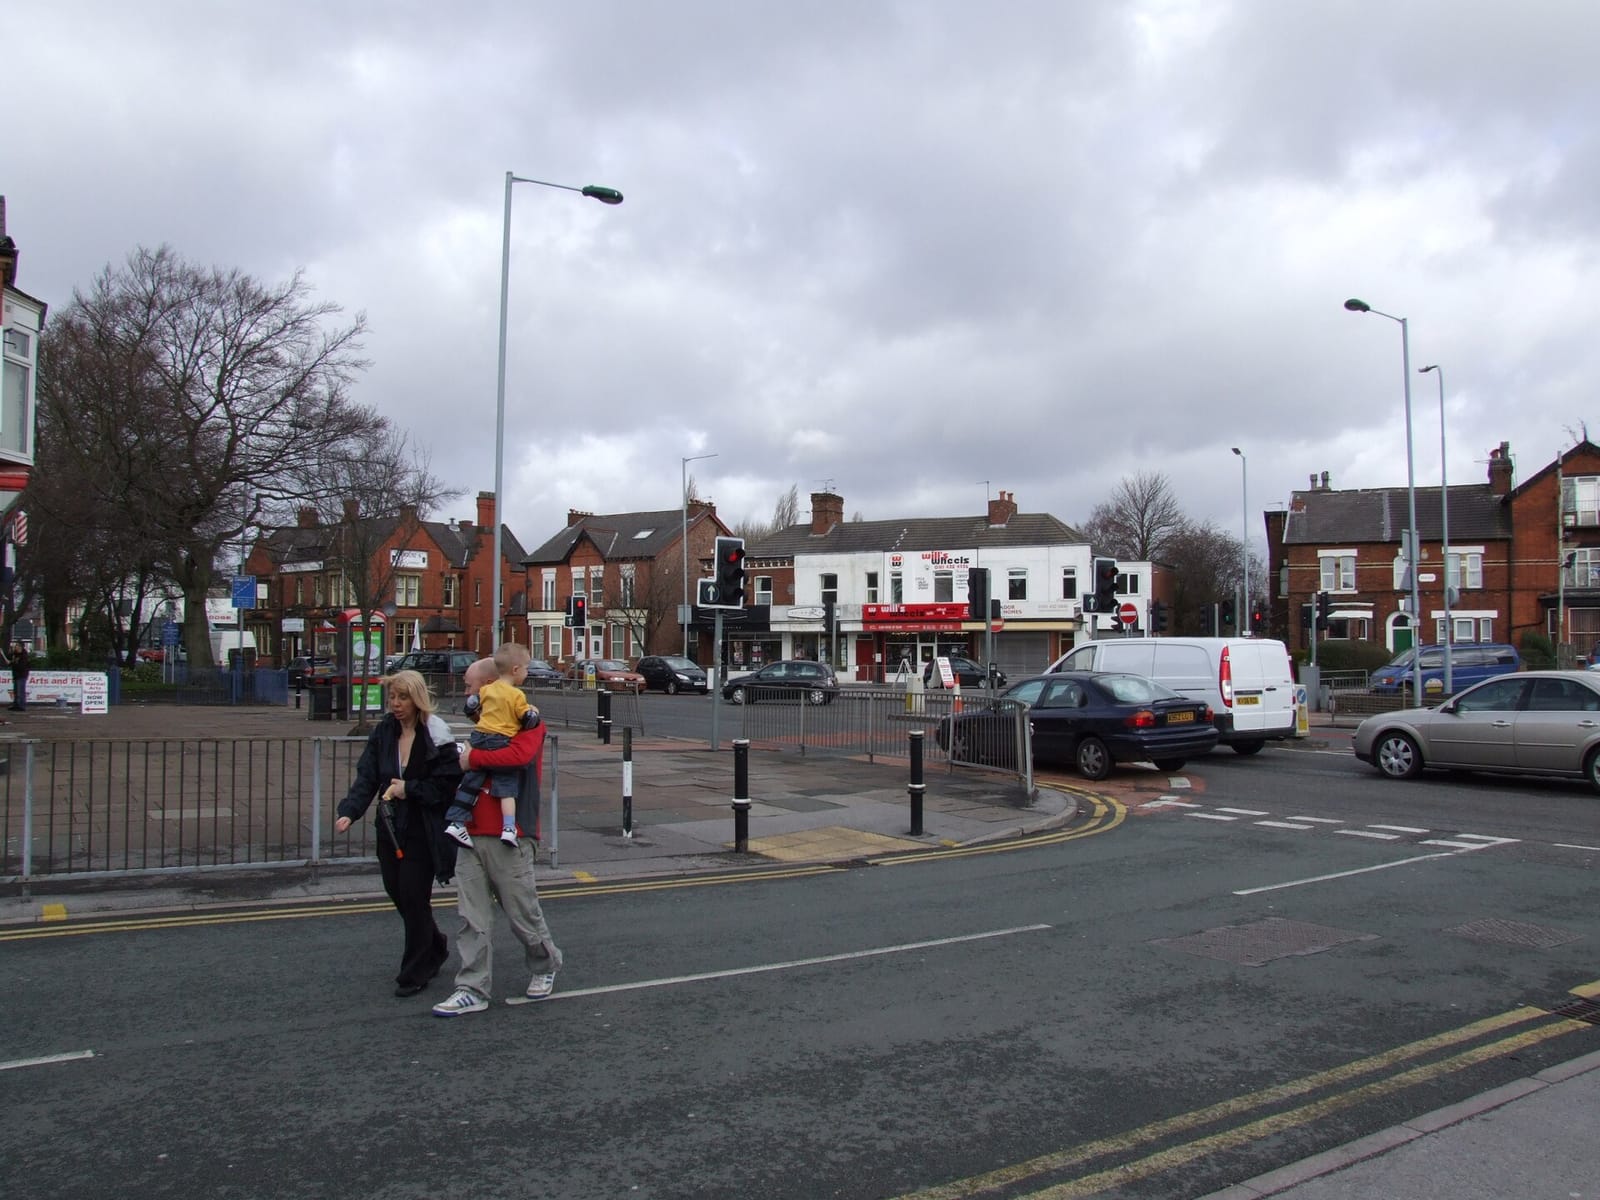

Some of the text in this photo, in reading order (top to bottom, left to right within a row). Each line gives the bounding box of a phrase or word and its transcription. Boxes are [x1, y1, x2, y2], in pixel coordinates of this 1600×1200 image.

[29, 677, 83, 685] Arts and Fit
